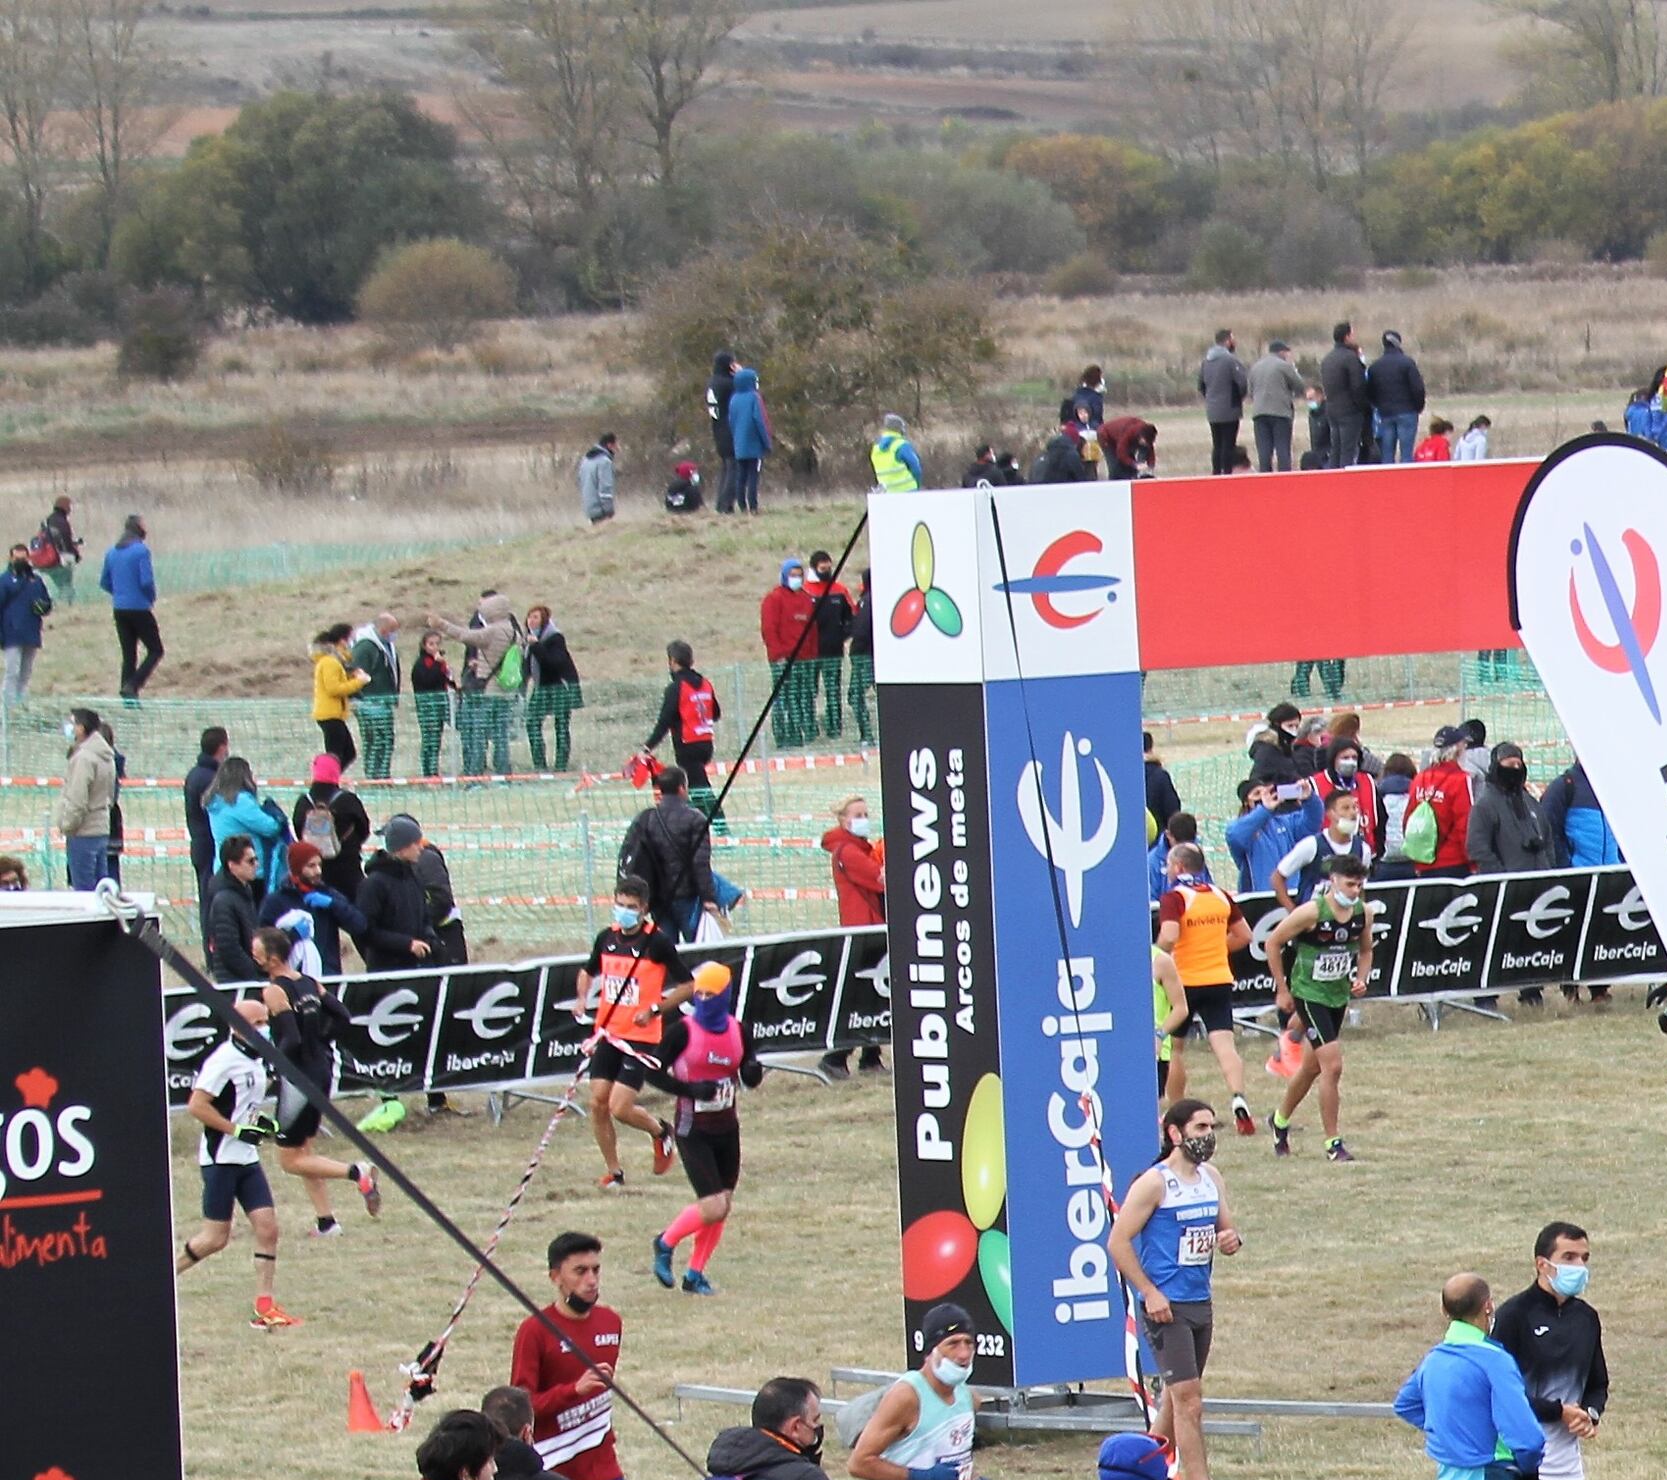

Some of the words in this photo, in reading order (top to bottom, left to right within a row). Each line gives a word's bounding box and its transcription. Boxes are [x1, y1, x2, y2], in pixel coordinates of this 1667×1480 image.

[948, 747, 966, 850] meta
[953, 862, 972, 904] de
[908, 746, 954, 1163] Publinews
[1502, 949, 1564, 970] iberCaja
[1594, 941, 1658, 961] iberCaja
[954, 920, 976, 1035] Arcos
[1411, 957, 1472, 978] iberCaja
[752, 1014, 817, 1041] iberCaja
[446, 1050, 516, 1073] iberCaja
[1042, 955, 1114, 1324] iberCaja
[976, 1333, 1005, 1356] 232
